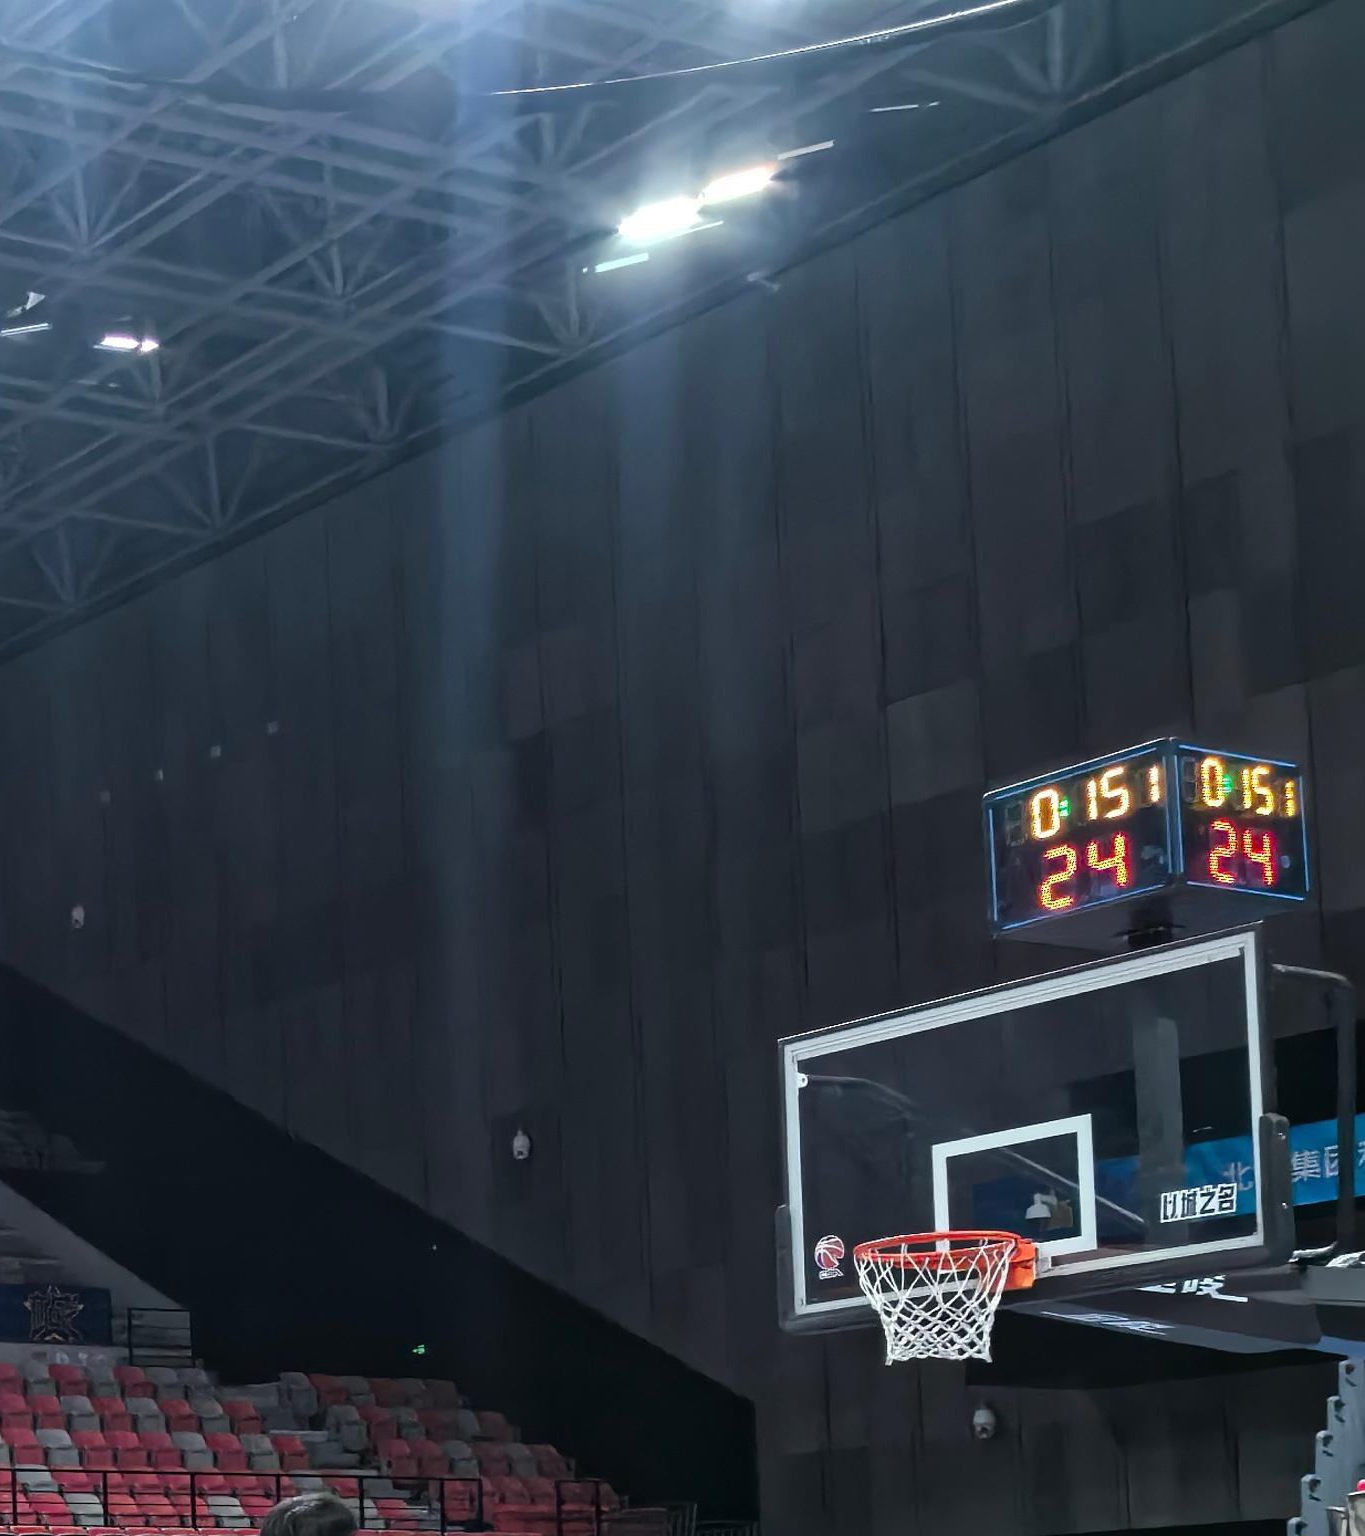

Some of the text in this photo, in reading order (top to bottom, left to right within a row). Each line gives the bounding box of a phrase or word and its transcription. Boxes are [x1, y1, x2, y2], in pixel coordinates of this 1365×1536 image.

[1040, 832, 1129, 911] 24
[1209, 819, 1277, 886] 24
[1161, 1182, 1237, 1222] 以城之名
